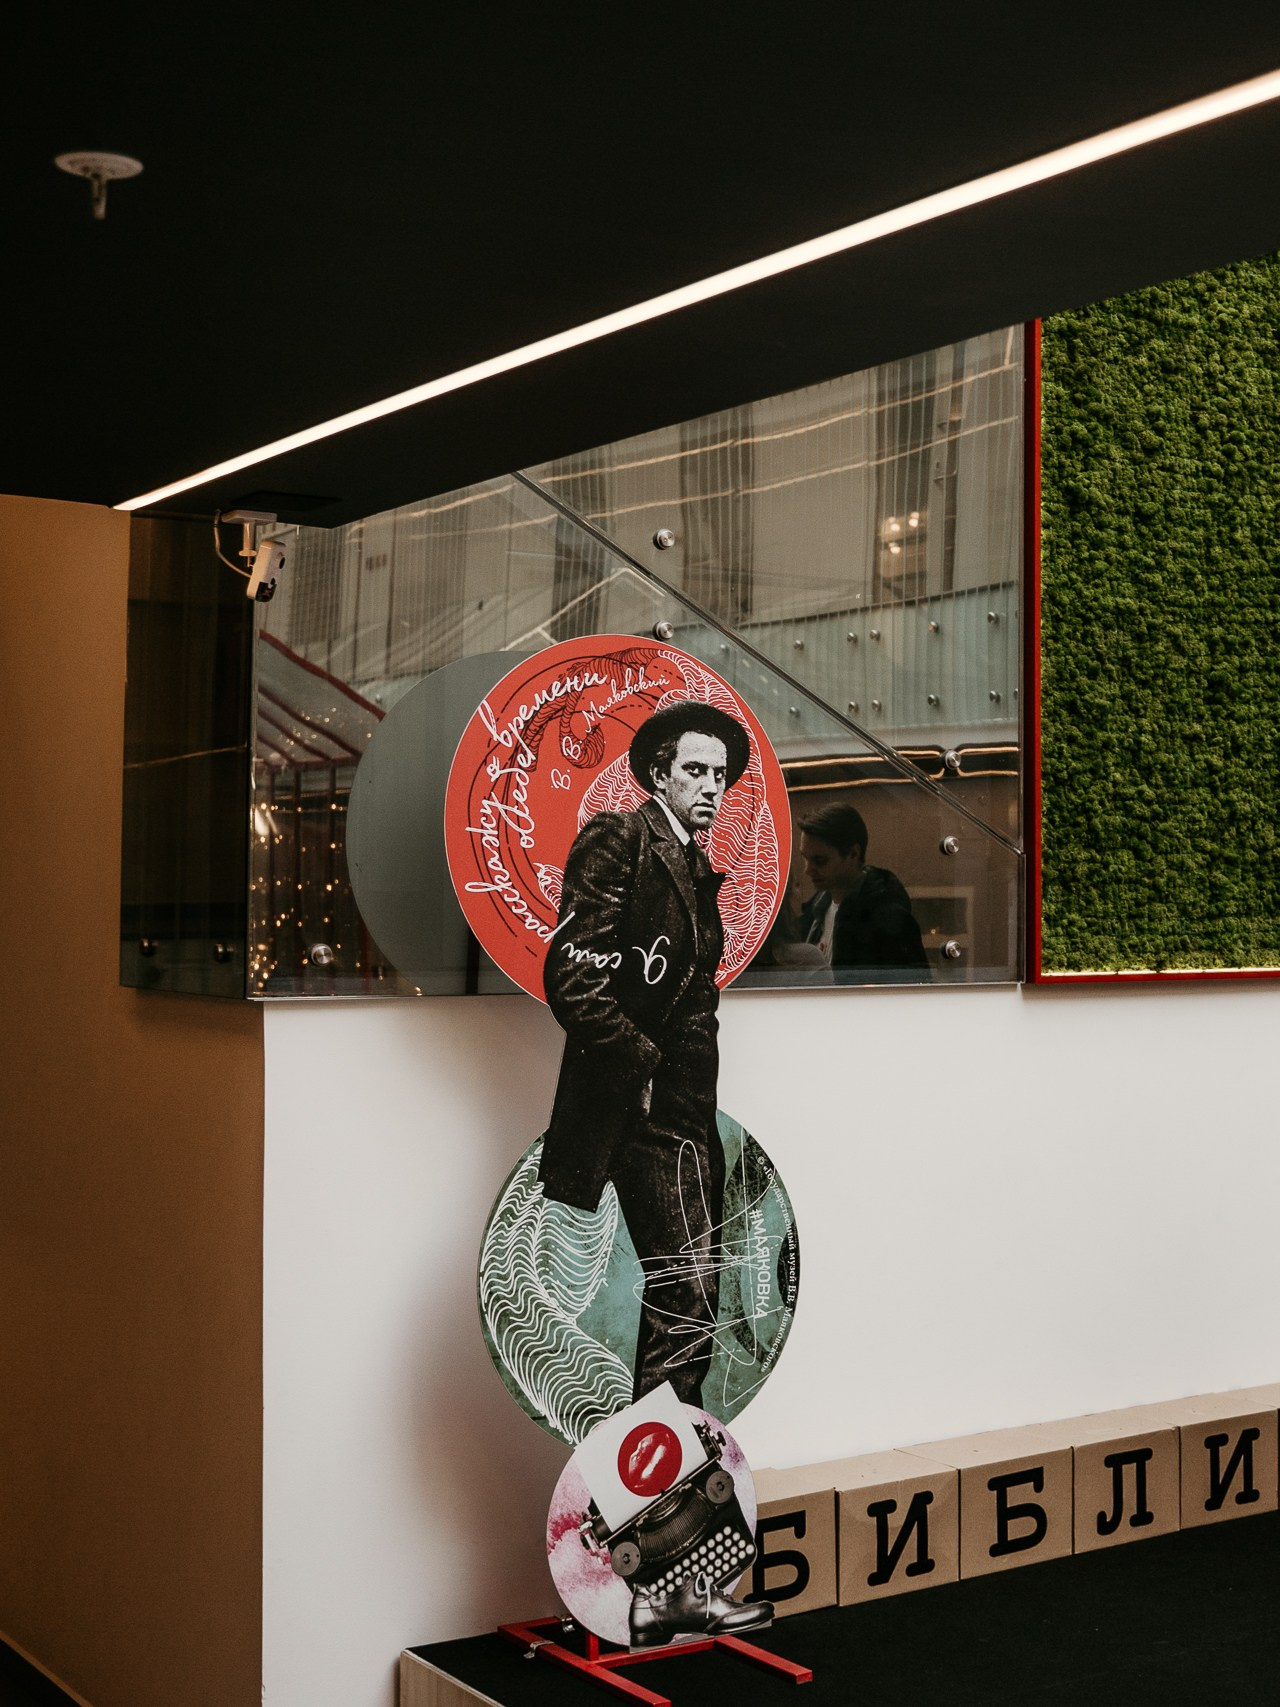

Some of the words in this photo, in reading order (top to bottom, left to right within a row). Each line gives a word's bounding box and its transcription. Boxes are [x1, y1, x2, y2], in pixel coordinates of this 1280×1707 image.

[477, 672, 607, 762] времени
[582, 667, 671, 733] Маяковский
[465, 791, 576, 943] расскажу
[561, 942, 622, 969] сам
[749, 1208, 771, 1320] #МАЯКОВКА
[788, 1252, 797, 1282] музей
